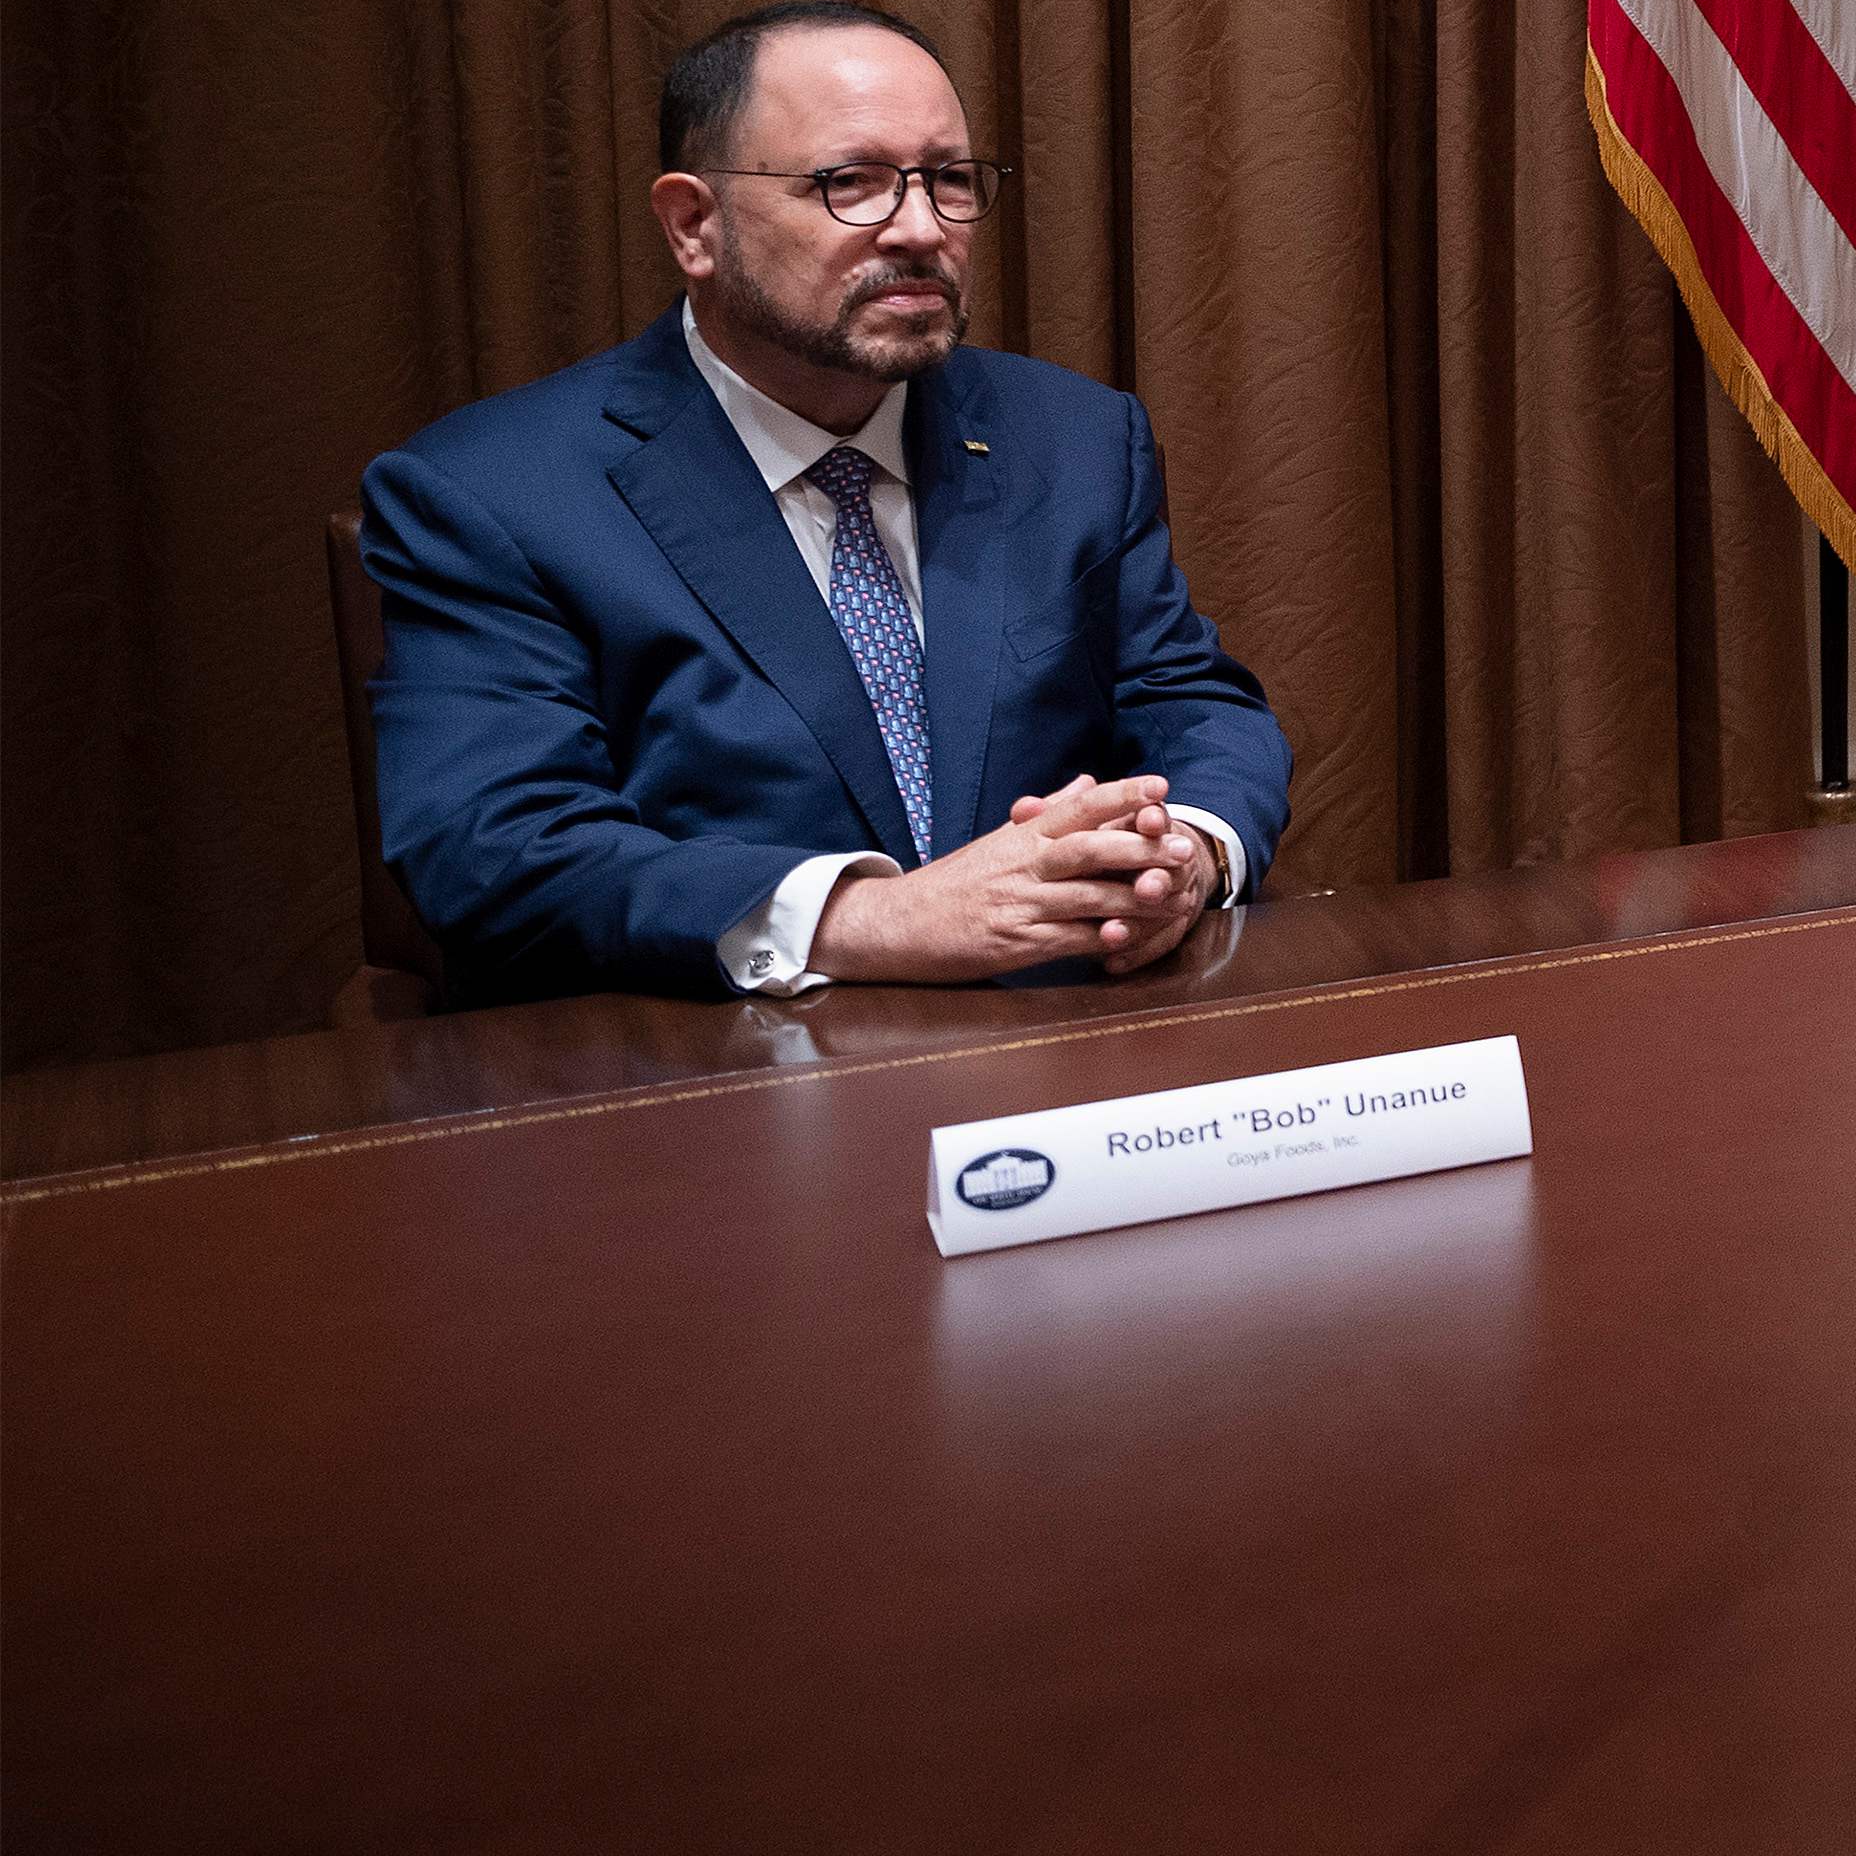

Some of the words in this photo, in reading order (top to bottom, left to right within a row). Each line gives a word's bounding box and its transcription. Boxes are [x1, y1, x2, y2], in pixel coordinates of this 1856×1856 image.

[1107, 1118, 1224, 1158] Robert
[1233, 1097, 1331, 1133] "Bob"
[1345, 1081, 1467, 1117] Unanue
[1226, 1148, 1271, 1169] Goya
